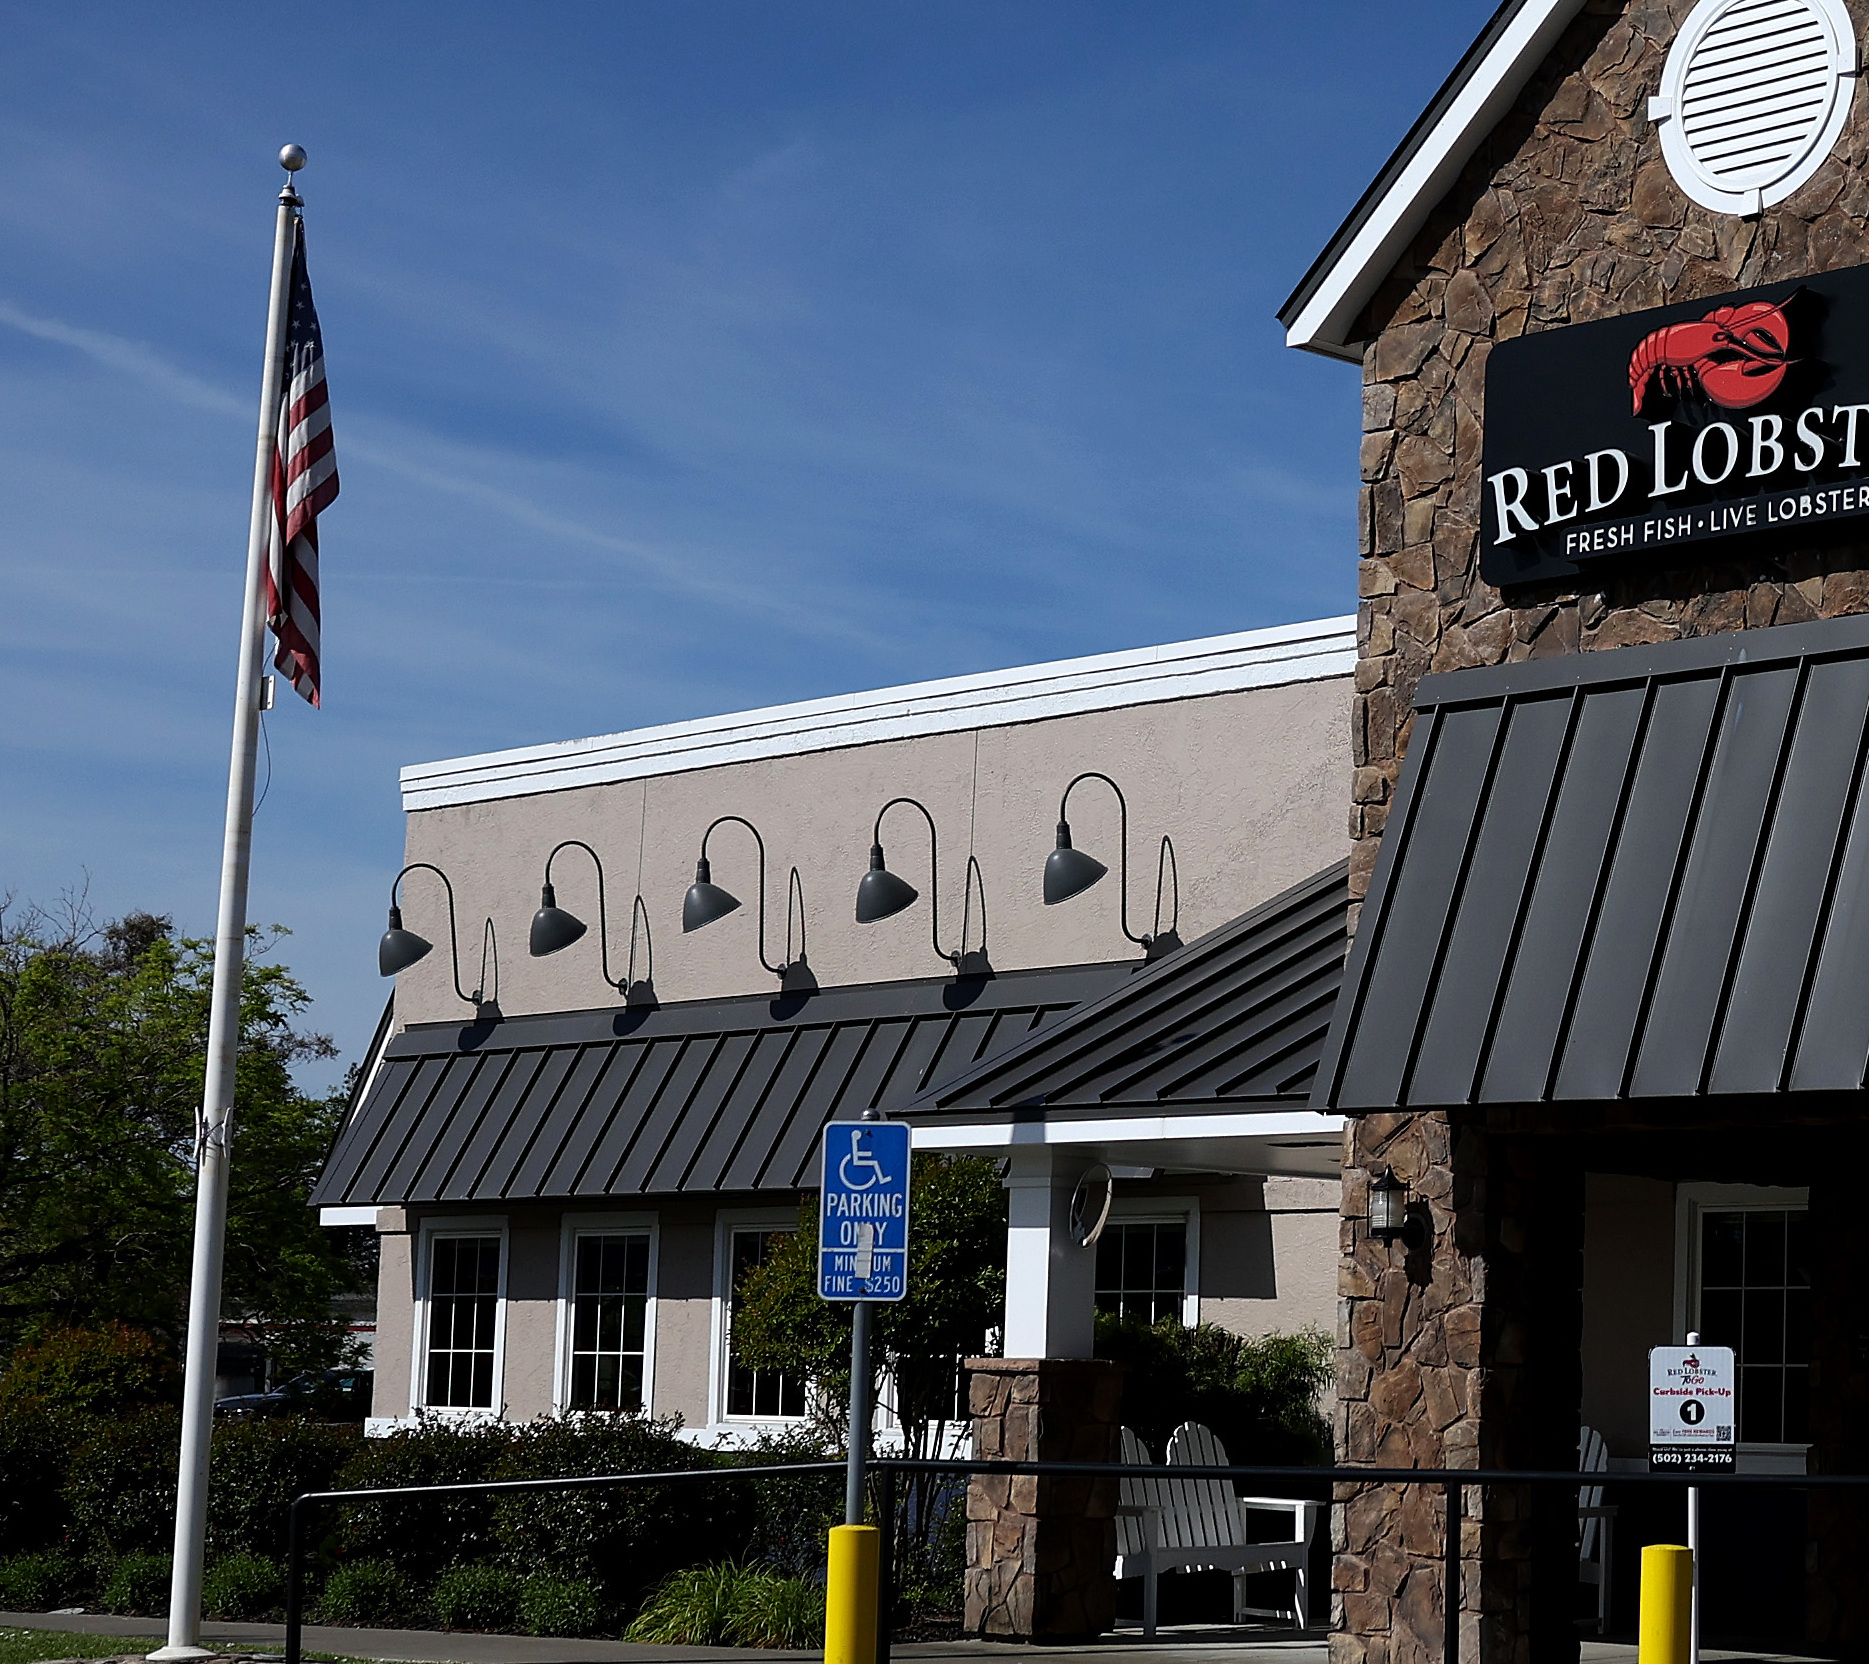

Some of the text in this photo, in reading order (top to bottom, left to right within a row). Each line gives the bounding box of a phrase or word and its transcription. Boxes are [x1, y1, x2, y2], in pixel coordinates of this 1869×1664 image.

[1486, 448, 1629, 546] RED
[1566, 523, 1634, 555] FRESH
[1643, 514, 1691, 543] FISH
[1710, 505, 1757, 532] LIVE
[827, 1193, 903, 1218] PARKING
[840, 1220, 888, 1246] ONY
[834, 1254, 891, 1272] MINUM
[824, 1275, 901, 1294] FINE $250
[1653, 1387, 1732, 1397] Curbside Pick-Up
[1686, 1403, 1697, 1421] 1
[1652, 1453, 1733, 1465] (502) 234-2176
